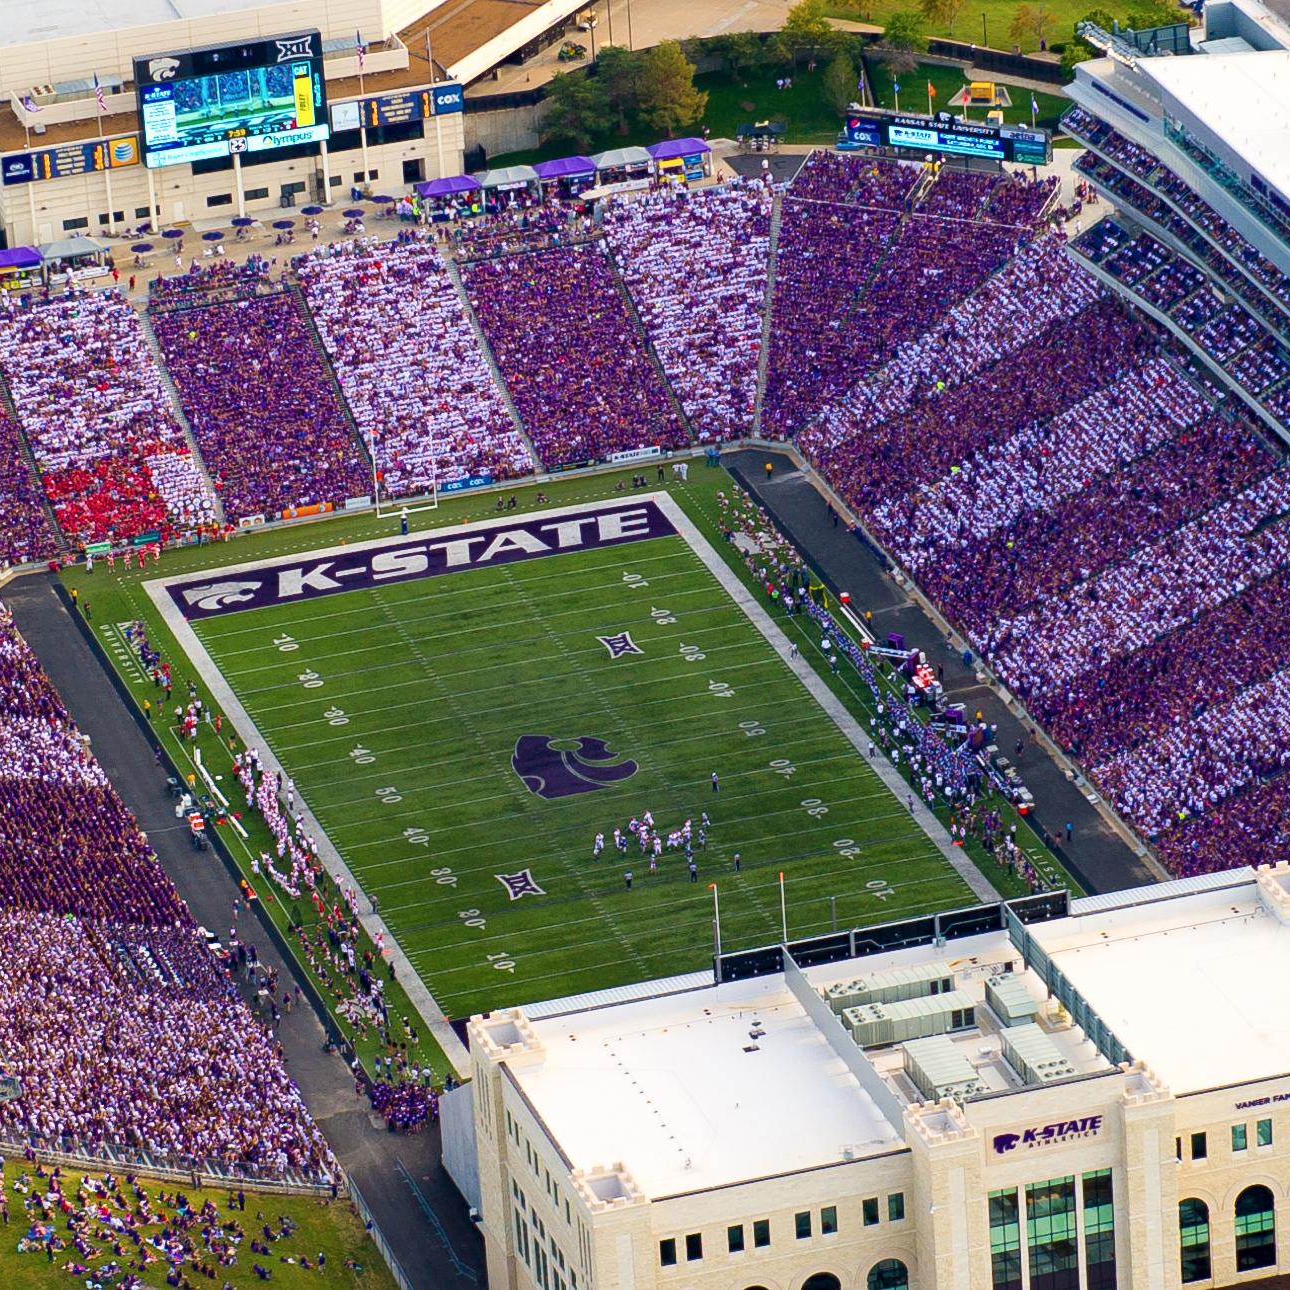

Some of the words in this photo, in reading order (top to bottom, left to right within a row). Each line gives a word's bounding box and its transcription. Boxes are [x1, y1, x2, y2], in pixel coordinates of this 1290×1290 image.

[277, 507, 650, 598] K-STATE
[1022, 1115, 1103, 1143] K-STATE
[1028, 1130, 1098, 1148] ATHLETICS
